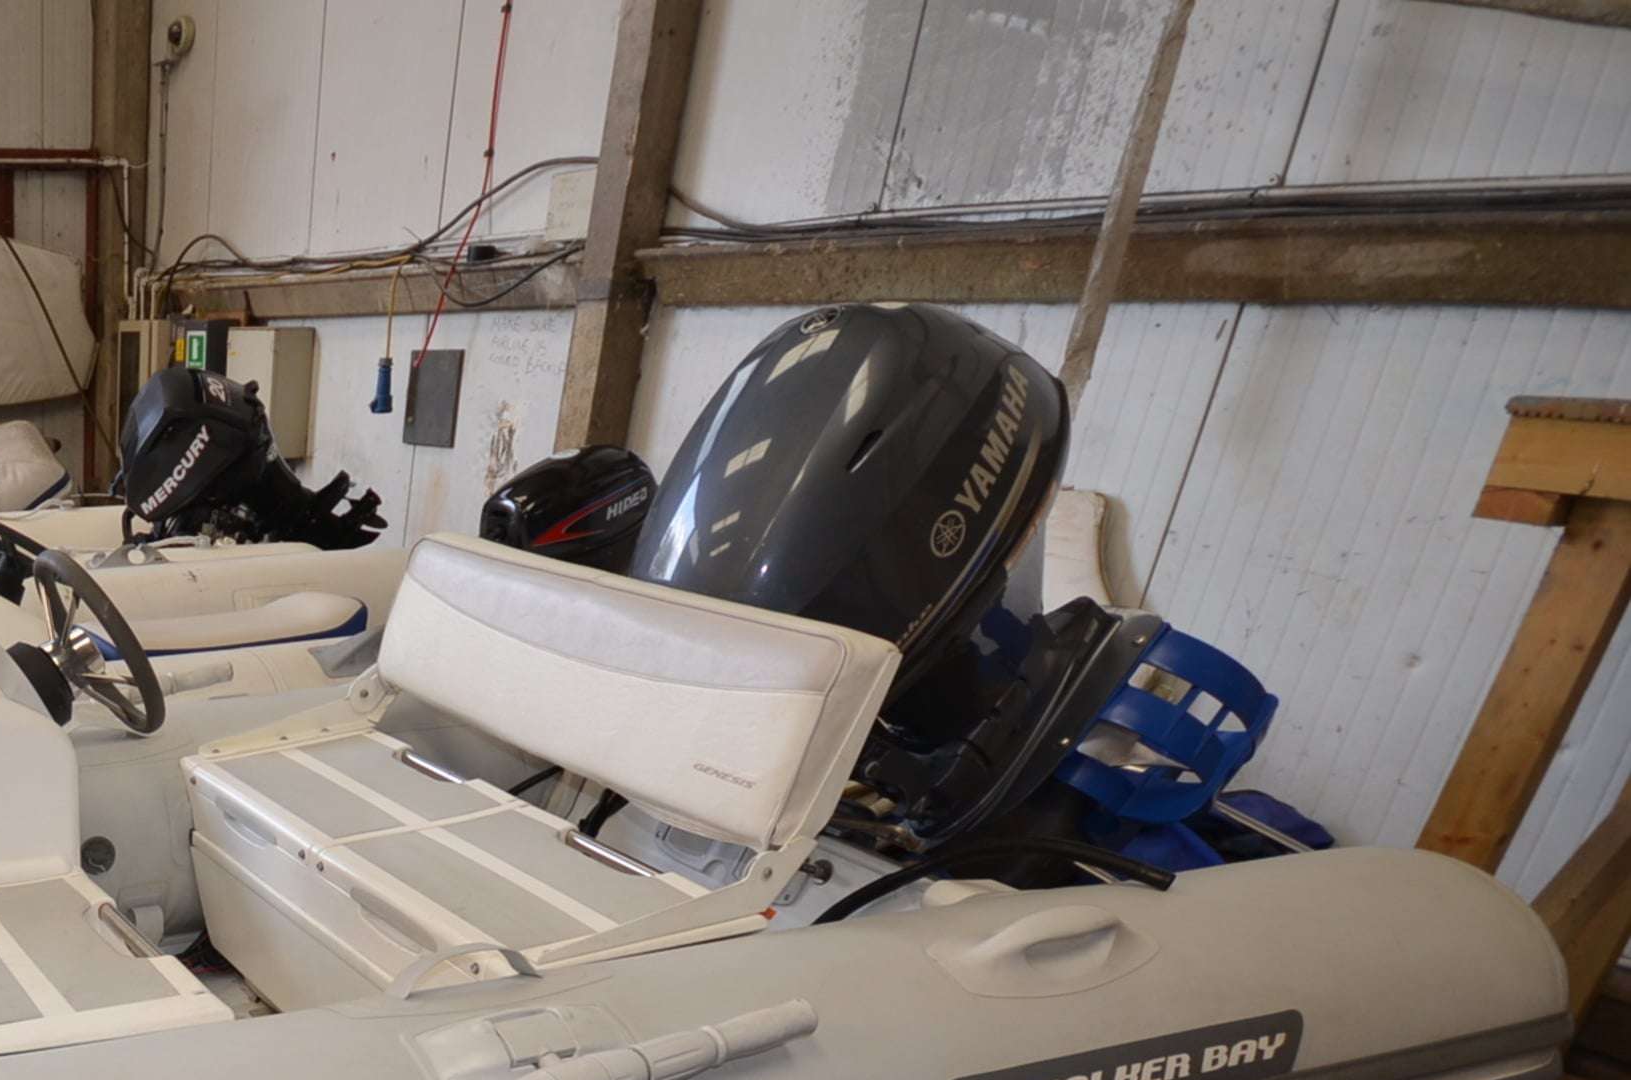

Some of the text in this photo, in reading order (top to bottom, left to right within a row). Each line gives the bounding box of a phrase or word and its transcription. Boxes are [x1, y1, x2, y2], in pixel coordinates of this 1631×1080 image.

[139, 423, 211, 516] MERCURY
[954, 364, 1029, 514] YAMAHA
[691, 762, 758, 790] GENESIS
[1200, 1031, 1286, 1073] BAY
